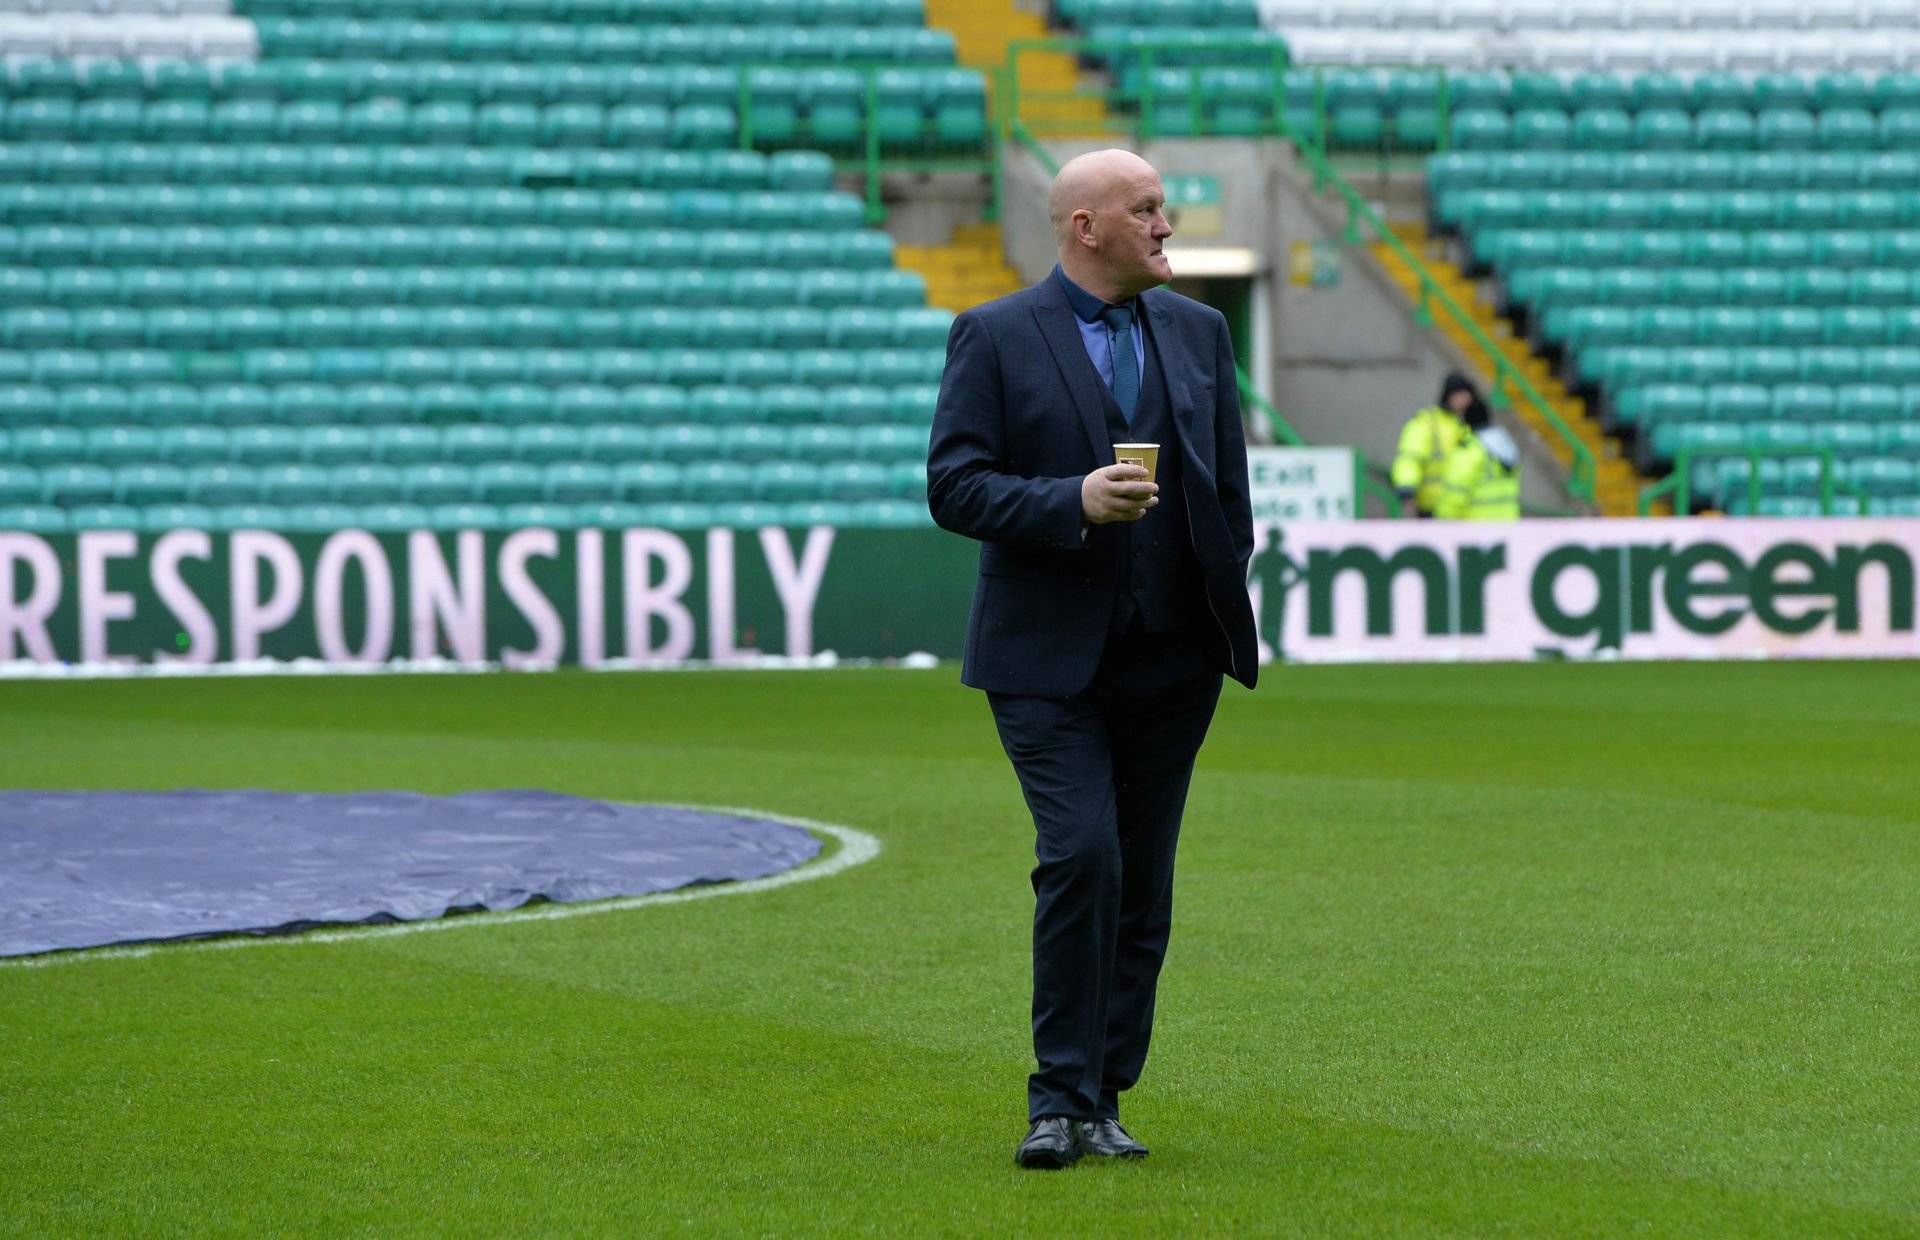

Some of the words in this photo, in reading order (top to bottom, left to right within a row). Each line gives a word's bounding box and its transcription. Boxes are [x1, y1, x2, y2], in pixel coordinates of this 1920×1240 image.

[1252, 497, 1298, 519] ate
[1315, 496, 1348, 519] 11
[1253, 462, 1315, 484] Exit
[0, 527, 836, 667] RESPONSIBLY
[1307, 544, 1507, 636] mr
[1530, 540, 1916, 660] green
